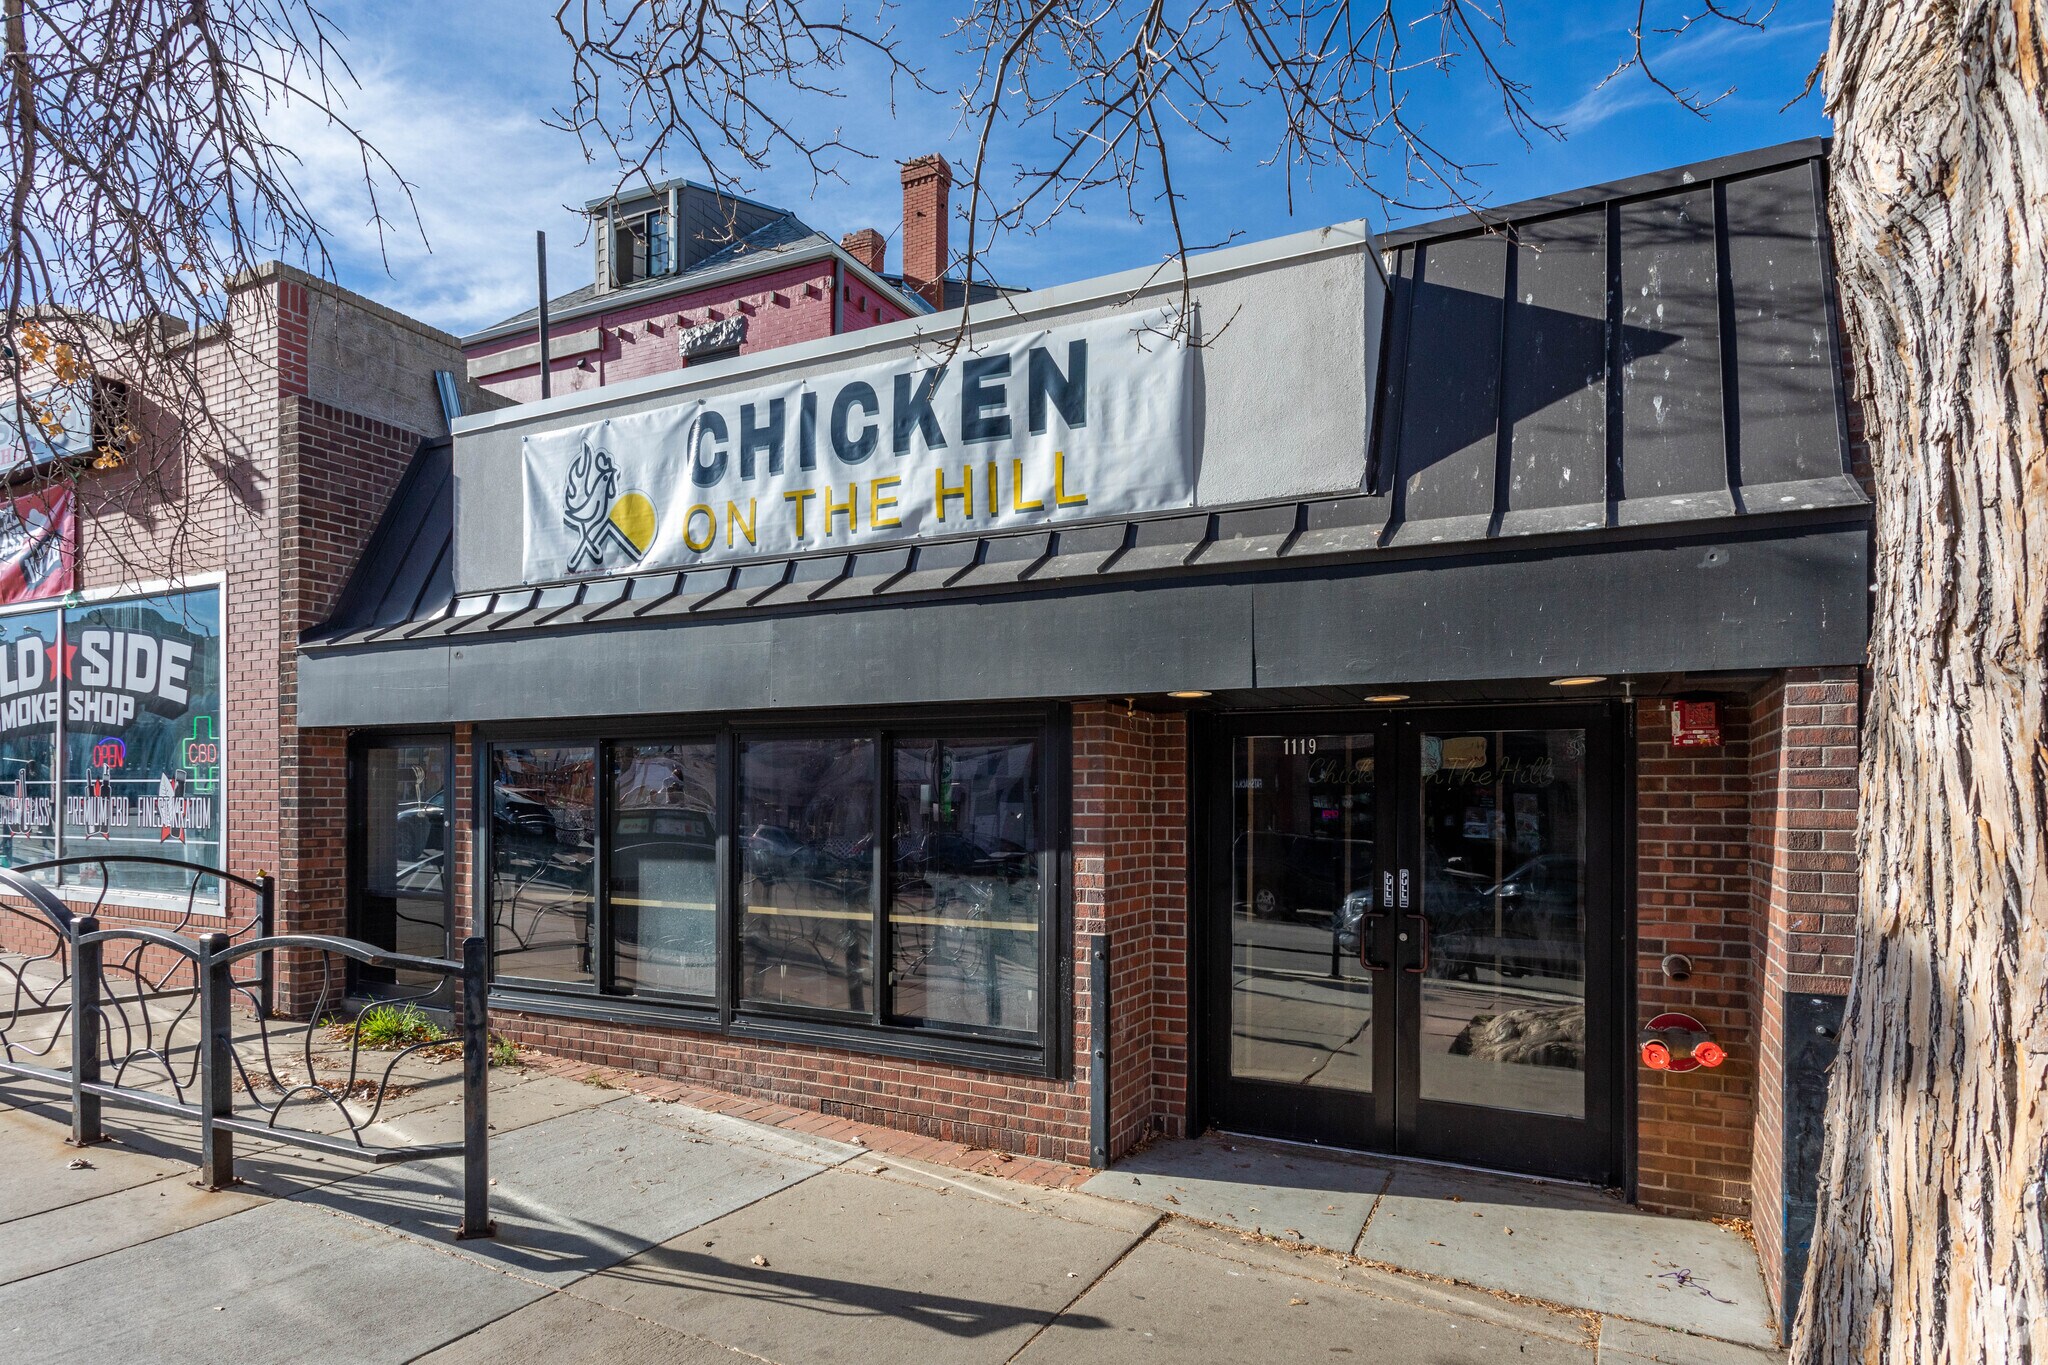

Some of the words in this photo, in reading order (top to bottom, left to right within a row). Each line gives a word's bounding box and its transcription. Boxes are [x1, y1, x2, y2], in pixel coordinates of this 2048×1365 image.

[687, 338, 1089, 489] CHICKEN
[683, 496, 757, 553] ON
[783, 475, 902, 541] THE
[936, 451, 1089, 522] HILL
[81, 630, 193, 705] SIDE
[0, 691, 58, 733] MOKE
[68, 690, 135, 726] SHOP
[93, 743, 125, 769] OPEN
[188, 743, 218, 763] CBD
[1283, 738, 1317, 755] 1119
[1447, 757, 1493, 786] The
[1500, 756, 1552, 785] Hill
[24, 797, 50, 826] GLASS
[66, 796, 108, 826] PREMIUM
[110, 796, 129, 827] CBD
[137, 797, 170, 828] FINEST
[172, 797, 211, 829] KRATOM
